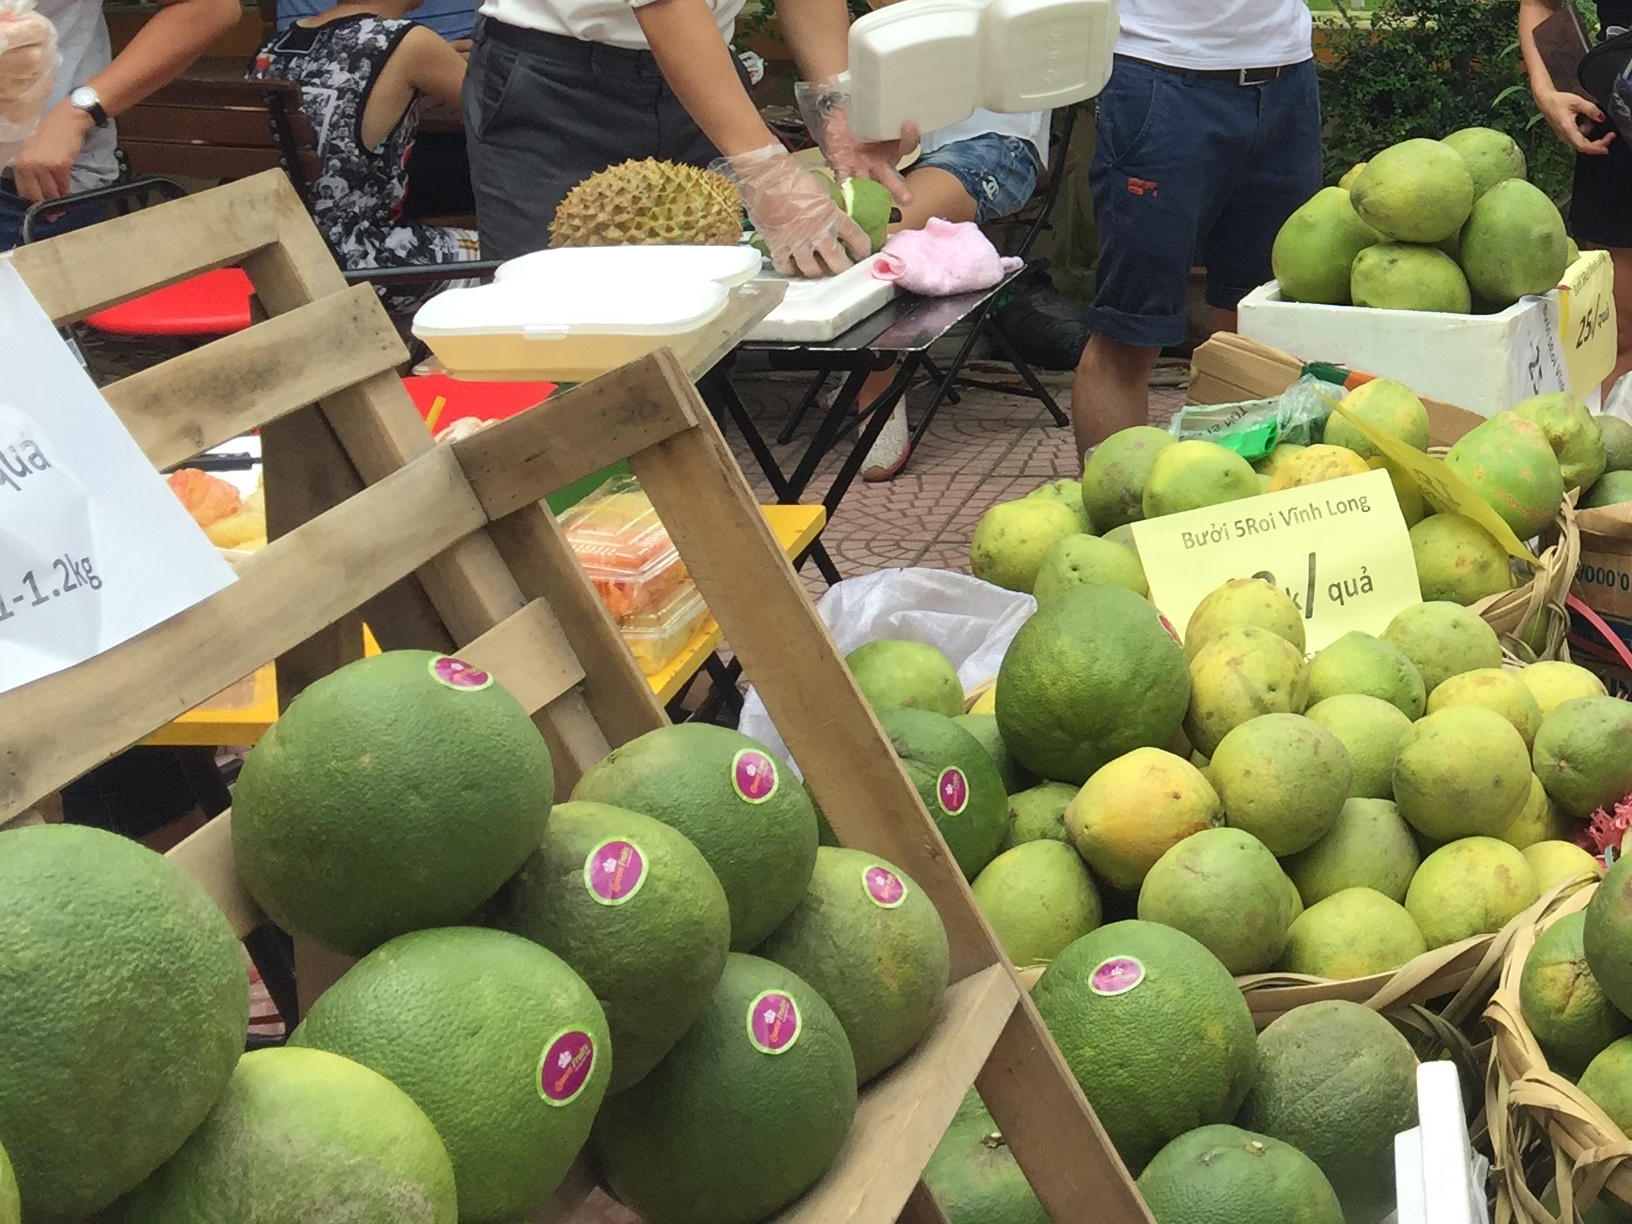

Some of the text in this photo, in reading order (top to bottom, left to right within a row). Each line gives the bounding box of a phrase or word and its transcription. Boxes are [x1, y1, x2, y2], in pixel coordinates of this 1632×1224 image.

[1182, 494, 1371, 550] Bưởi 5Roi Vĩnh Long
[1328, 566, 1374, 606] quả
